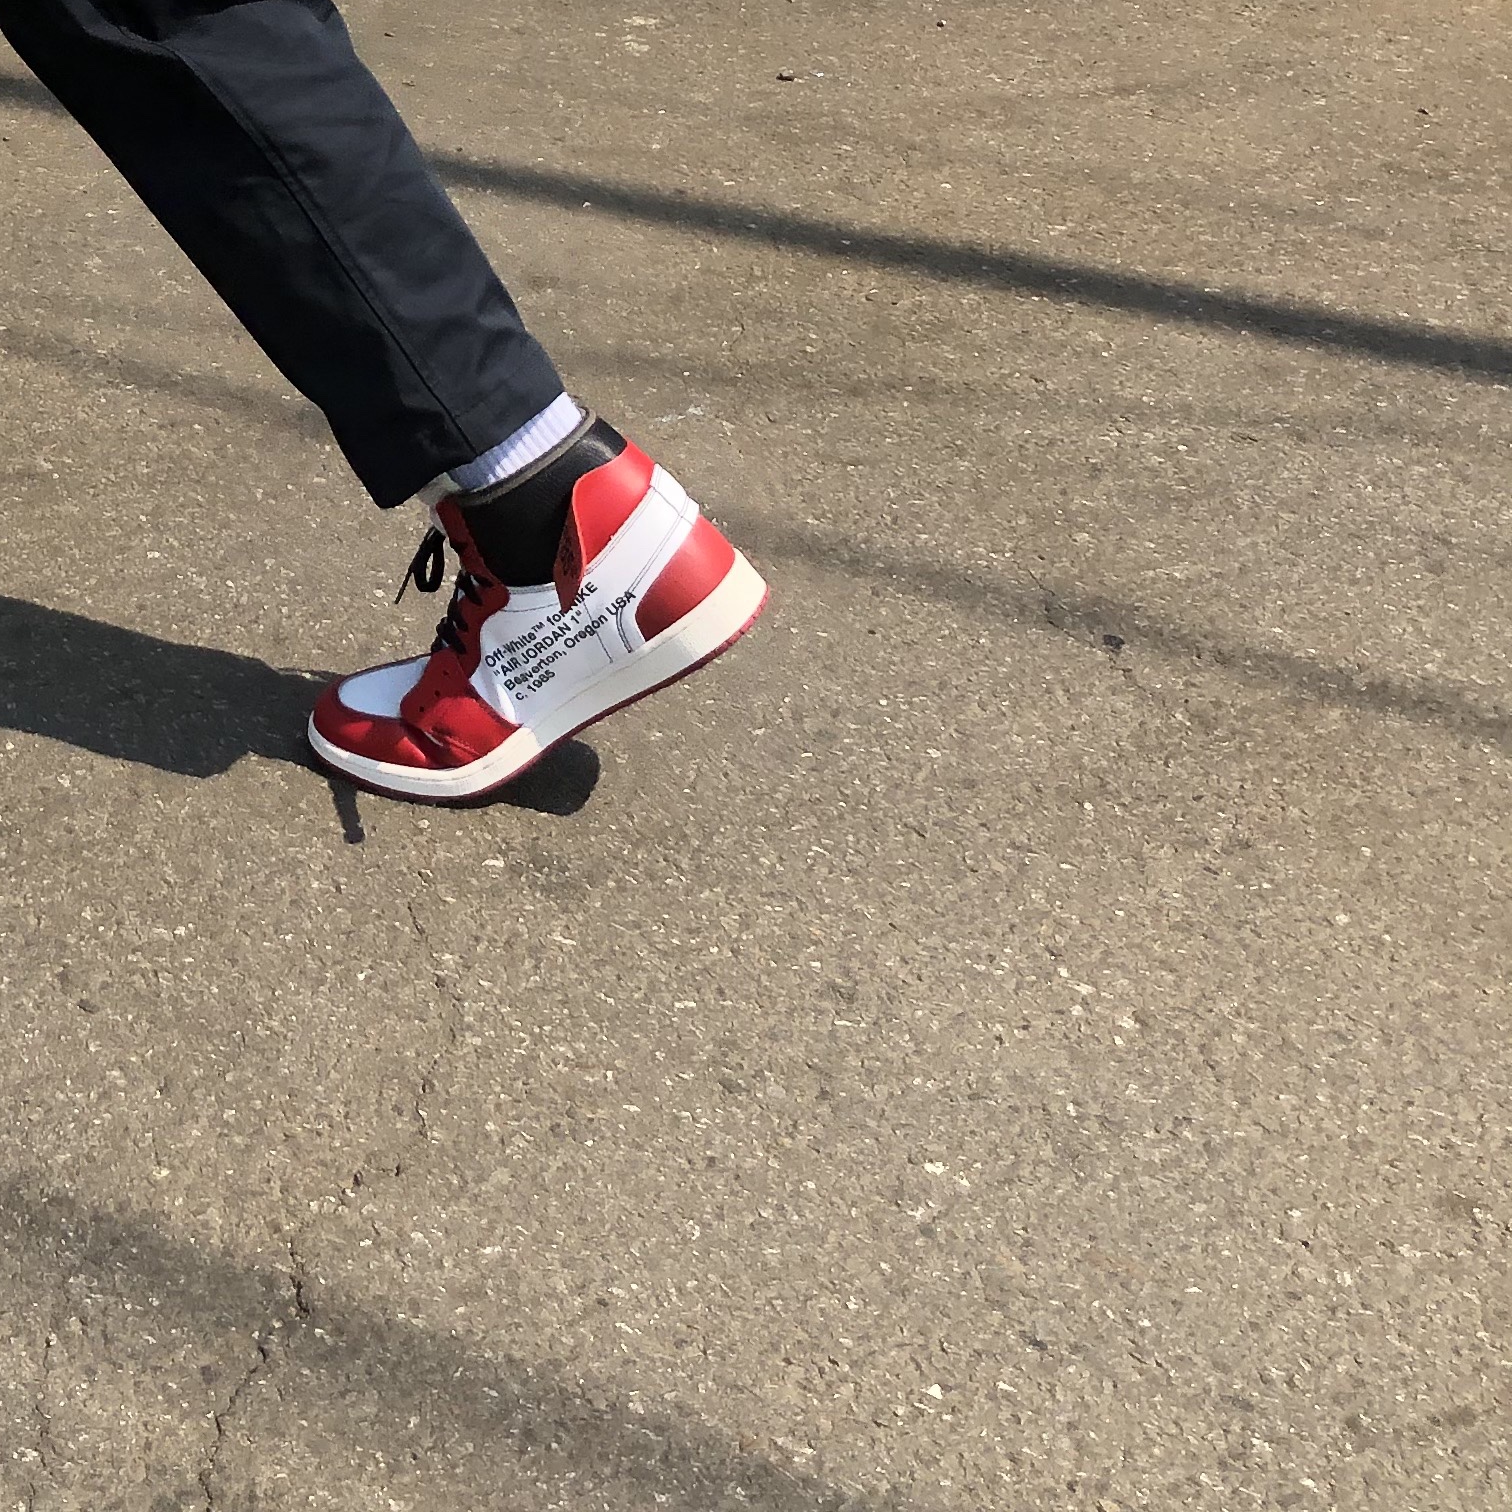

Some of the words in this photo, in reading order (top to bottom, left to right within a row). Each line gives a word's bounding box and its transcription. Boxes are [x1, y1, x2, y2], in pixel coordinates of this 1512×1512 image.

[504, 650, 567, 691] Beaverton,
[564, 614, 608, 648] Oregon
[605, 591, 636, 616] USA
[521, 622, 571, 664] JORDAN
[527, 670, 555, 692] 1985
